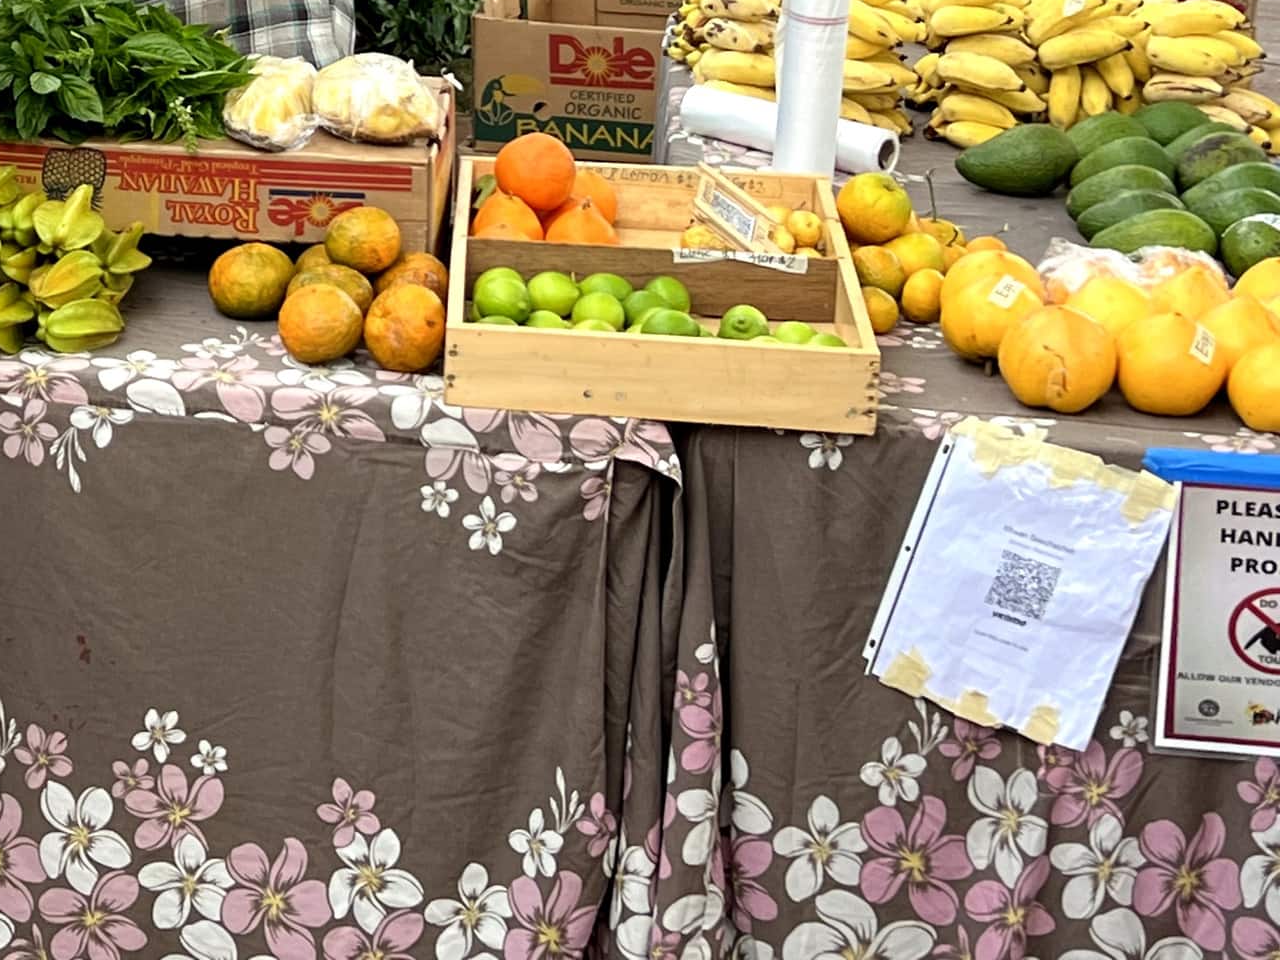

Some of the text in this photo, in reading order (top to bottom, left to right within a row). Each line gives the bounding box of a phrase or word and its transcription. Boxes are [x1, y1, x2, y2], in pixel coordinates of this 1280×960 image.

[549, 34, 656, 81] Dole
[570, 90, 635, 104] CERTIFIED
[564, 102, 642, 120] ORGANIC
[620, 168, 669, 183] Lemon
[120, 171, 258, 202] HAWAIIAN
[166, 200, 258, 233] ROYAL
[1230, 557, 1278, 575] PRO
[1260, 600, 1278, 608] DO
[1178, 672, 1215, 681] ALLOW
[1218, 675, 1242, 684] OUR
